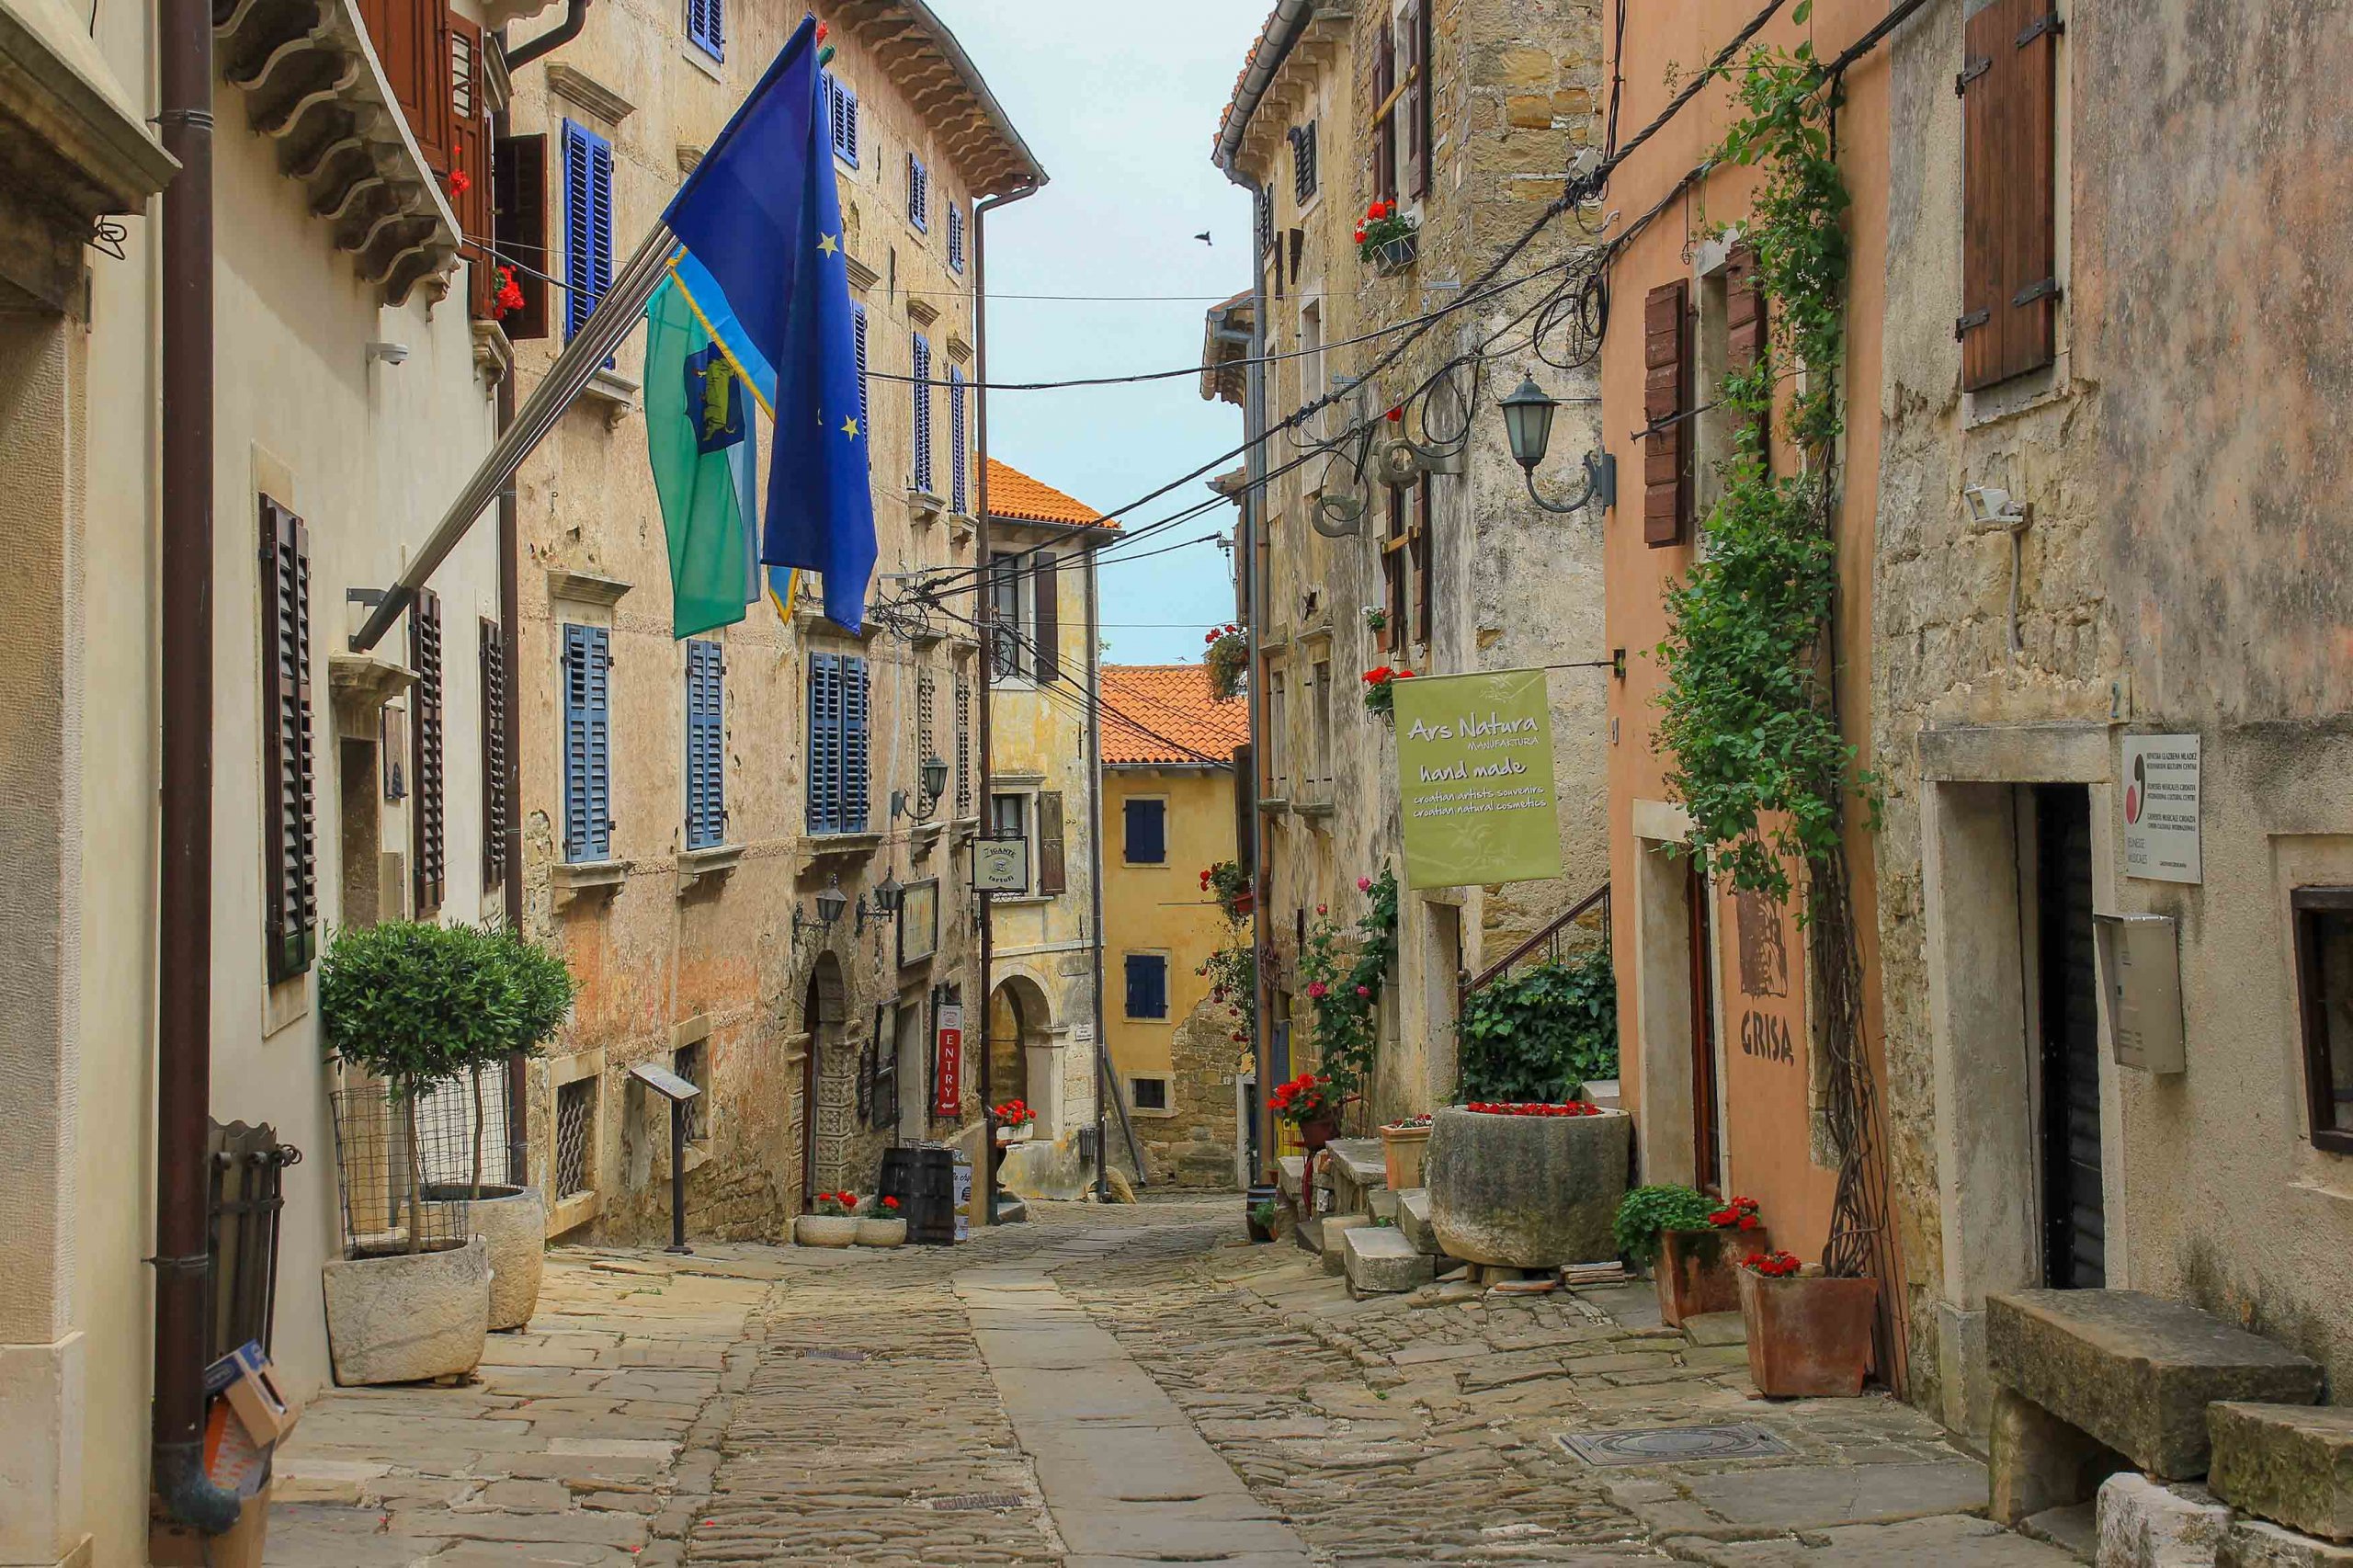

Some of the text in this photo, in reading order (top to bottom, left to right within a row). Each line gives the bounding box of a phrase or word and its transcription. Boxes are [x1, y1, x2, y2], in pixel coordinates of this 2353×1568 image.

[1407, 711, 1539, 743] Ars Natura
[1467, 736, 1539, 752] MANUFAKTURA
[1420, 756, 1527, 783] hand made
[1413, 797, 1547, 818] croatian natural cosmetics
[1414, 785, 1544, 805] croatian artists souvenirs
[1741, 1010, 1794, 1067] GRISA
[945, 1034, 954, 1097] ENTRY
